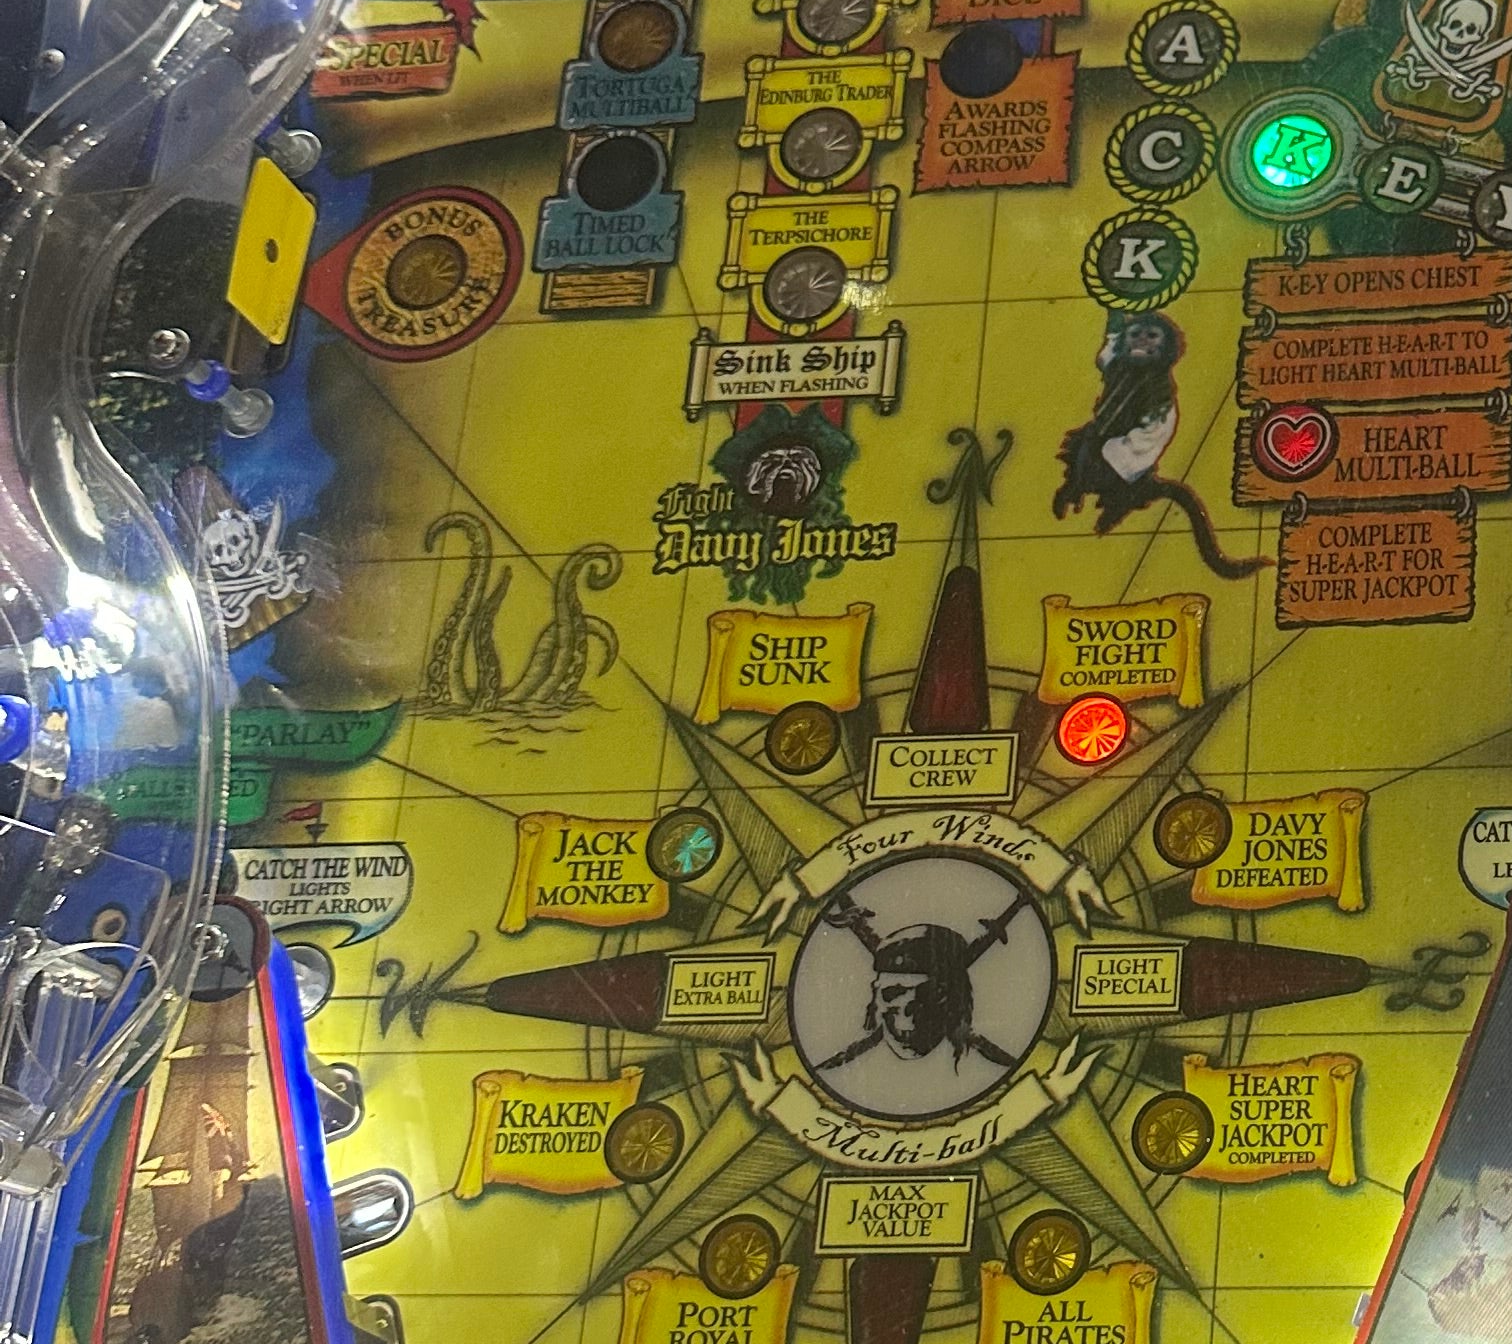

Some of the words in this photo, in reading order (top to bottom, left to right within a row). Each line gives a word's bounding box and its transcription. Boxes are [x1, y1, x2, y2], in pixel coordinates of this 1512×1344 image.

[327, 37, 447, 72] SPECIAL
[1159, 25, 1205, 65] A
[574, 73, 687, 99] TORTUGA
[808, 70, 842, 85] THE
[760, 87, 834, 106] EDINBURG
[836, 83, 894, 102] TRADER
[568, 98, 687, 120] MULTIBALL
[944, 101, 1048, 121] AWARDS
[938, 119, 1052, 139] FLASHING
[940, 137, 1046, 157] COMPASS
[1139, 130, 1184, 173] C
[946, 155, 1037, 175] ARROW
[386, 205, 482, 241] BONUS
[574, 212, 646, 236] TIMED
[793, 211, 829, 226] THE
[546, 237, 603, 257] BALL
[606, 234, 666, 254] LOCK
[750, 227, 873, 247] TERPSICHORE
[1113, 237, 1167, 281] K
[1334, 269, 1405, 295] OPENS
[1411, 265, 1483, 290] CHEST
[357, 277, 491, 337] TREASURE
[1273, 337, 1373, 360] COMPLETE
[1460, 330, 1490, 351] TO
[713, 348, 791, 377] Sink
[802, 345, 876, 375] Ship
[1259, 364, 1318, 386] LIGHT
[1321, 360, 1386, 383] HEART
[719, 380, 776, 396] WHEN
[780, 375, 869, 394] FLASHING
[1363, 425, 1449, 454] HEART
[1334, 452, 1482, 484] MULTI-BALL
[653, 482, 735, 523] Fight
[652, 520, 763, 576] Davy
[771, 517, 899, 565] Jones
[1318, 521, 1433, 549] COMPLETE
[1402, 548, 1445, 571] FOR
[1289, 579, 1358, 604] SUPER
[1362, 574, 1460, 605] JACKPOT
[1067, 617, 1178, 643] SWORD
[749, 631, 828, 660] SHIP
[1075, 642, 1168, 667] FIGHT
[739, 659, 831, 687] SUNK
[1060, 666, 1177, 688] COMPLETED
[889, 744, 999, 768] COLLECT
[909, 767, 979, 788] CREW
[1248, 812, 1327, 837] DAVY
[553, 828, 638, 863] JACK
[836, 827, 916, 866] Four
[932, 813, 1036, 862] Winds
[1242, 838, 1328, 867] JONES
[244, 858, 307, 880] CATCH
[313, 857, 350, 878] THE
[355, 855, 408, 878] WIND
[567, 859, 624, 882] THE
[1216, 866, 1329, 889] DEFEATED
[289, 881, 350, 897] LIGHTS
[536, 883, 654, 906] MONKEY
[319, 897, 394, 915] ARROW
[690, 970, 757, 988] LIGHT
[1096, 958, 1164, 976] LIGHT
[673, 989, 723, 1006] EXTRA
[726, 988, 764, 1005] BALL
[1084, 976, 1172, 995] SPECIAL
[1227, 1073, 1320, 1097] HEART
[498, 1099, 610, 1129] KRAKEN
[1229, 1099, 1313, 1121] SUPER
[494, 1131, 601, 1154] DESTROYED
[802, 1113, 1005, 1165] Multi-ball
[1219, 1122, 1329, 1153] JACKPOT
[1228, 1150, 1316, 1165] COMPLETED
[868, 1184, 927, 1201] MAX
[847, 1199, 949, 1225] JACKPOT
[862, 1220, 933, 1238] VALUE
[676, 1302, 758, 1329] PORT
[1037, 1300, 1094, 1324] ALL
